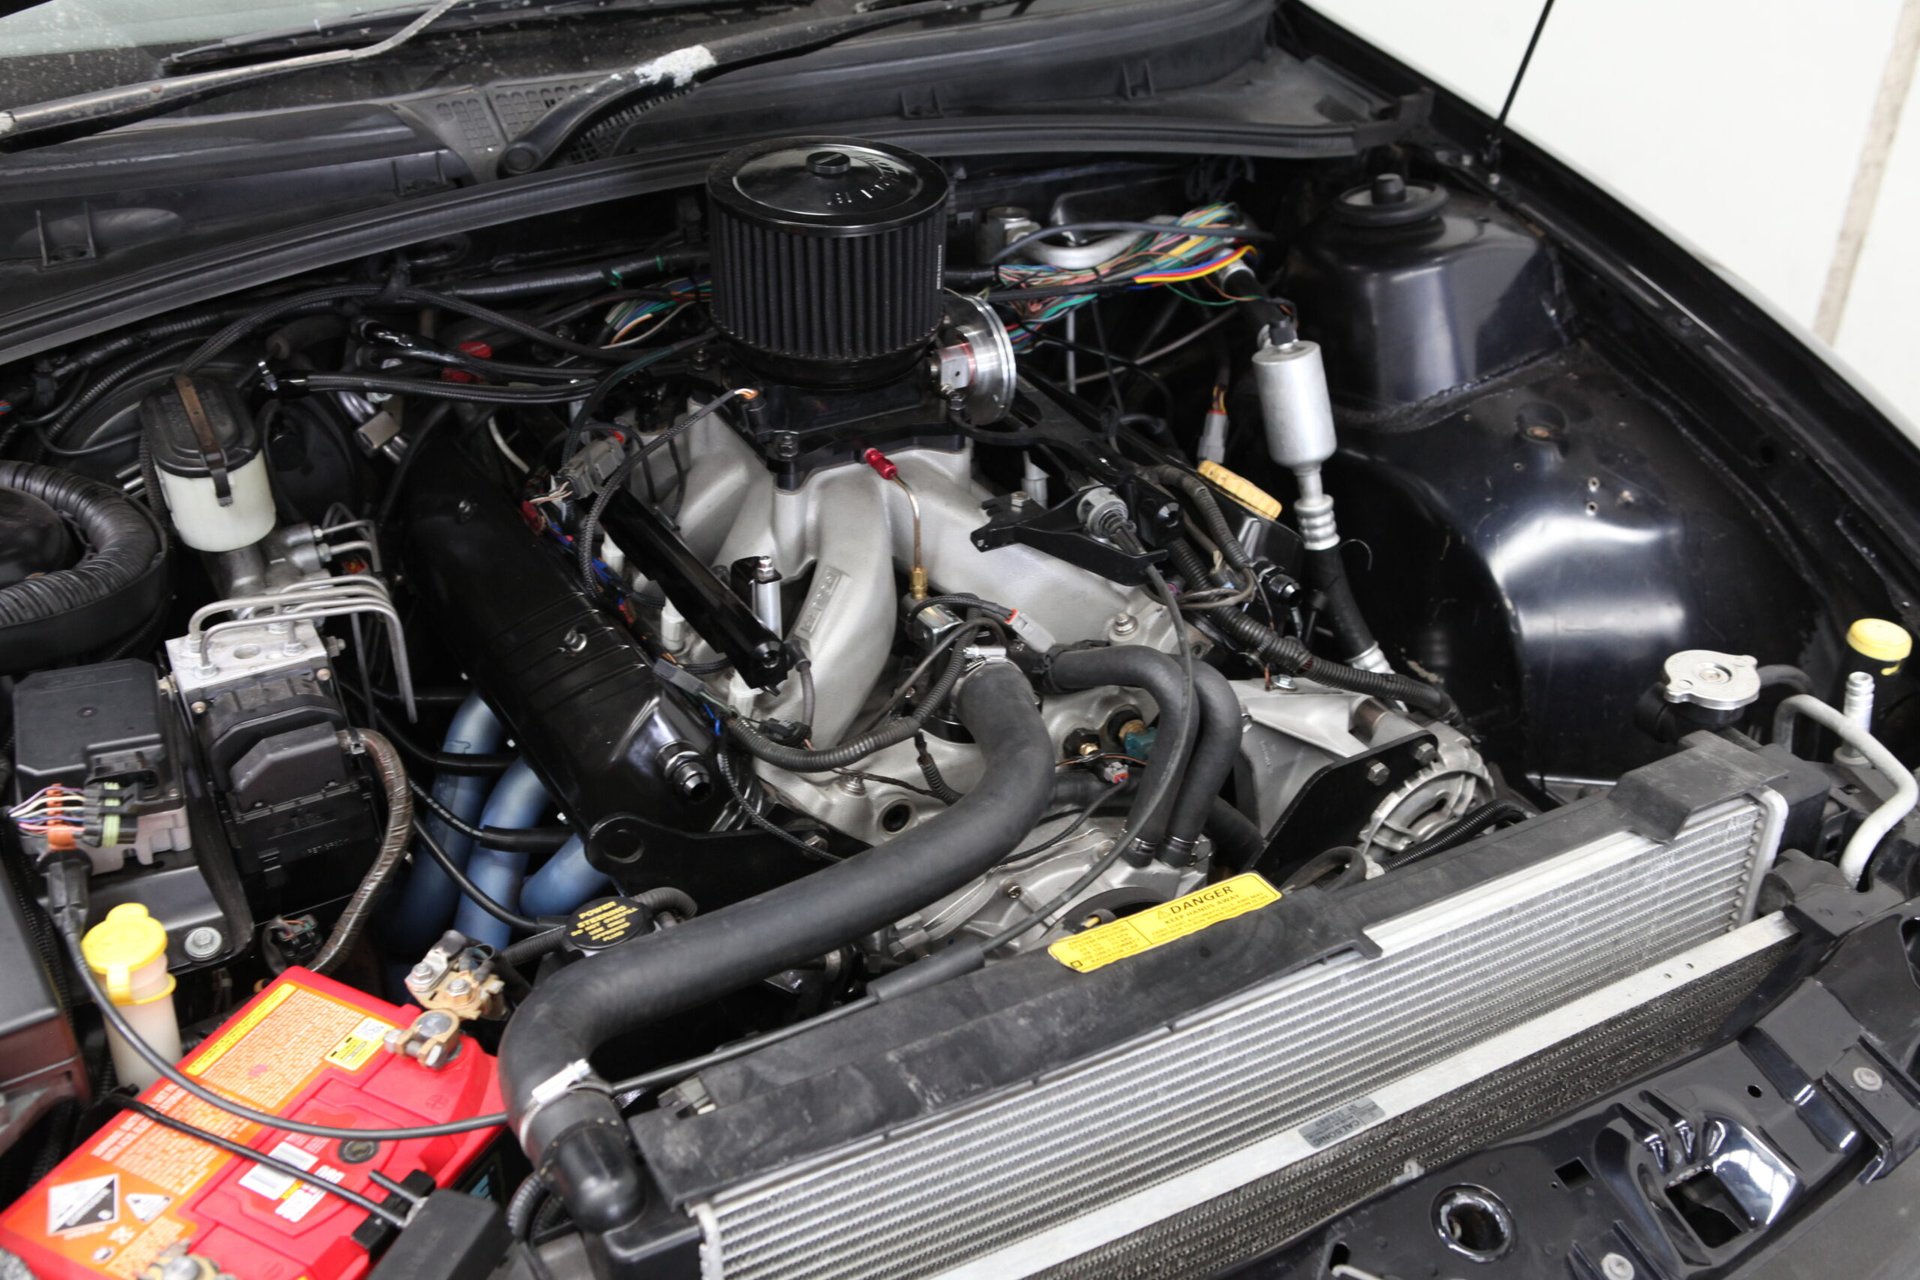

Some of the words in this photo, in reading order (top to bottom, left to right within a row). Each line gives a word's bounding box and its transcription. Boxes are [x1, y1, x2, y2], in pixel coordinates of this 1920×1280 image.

[579, 901, 617, 919] POWER
[1165, 913, 1184, 925] KEEP
[1185, 903, 1215, 918] HANDS
[1216, 894, 1240, 905] AWAY
[1170, 886, 1233, 914] DANGER
[577, 906, 627, 928] STEERING
[585, 922, 600, 931] NOT
[1313, 1119, 1360, 1146] CALSONIC
